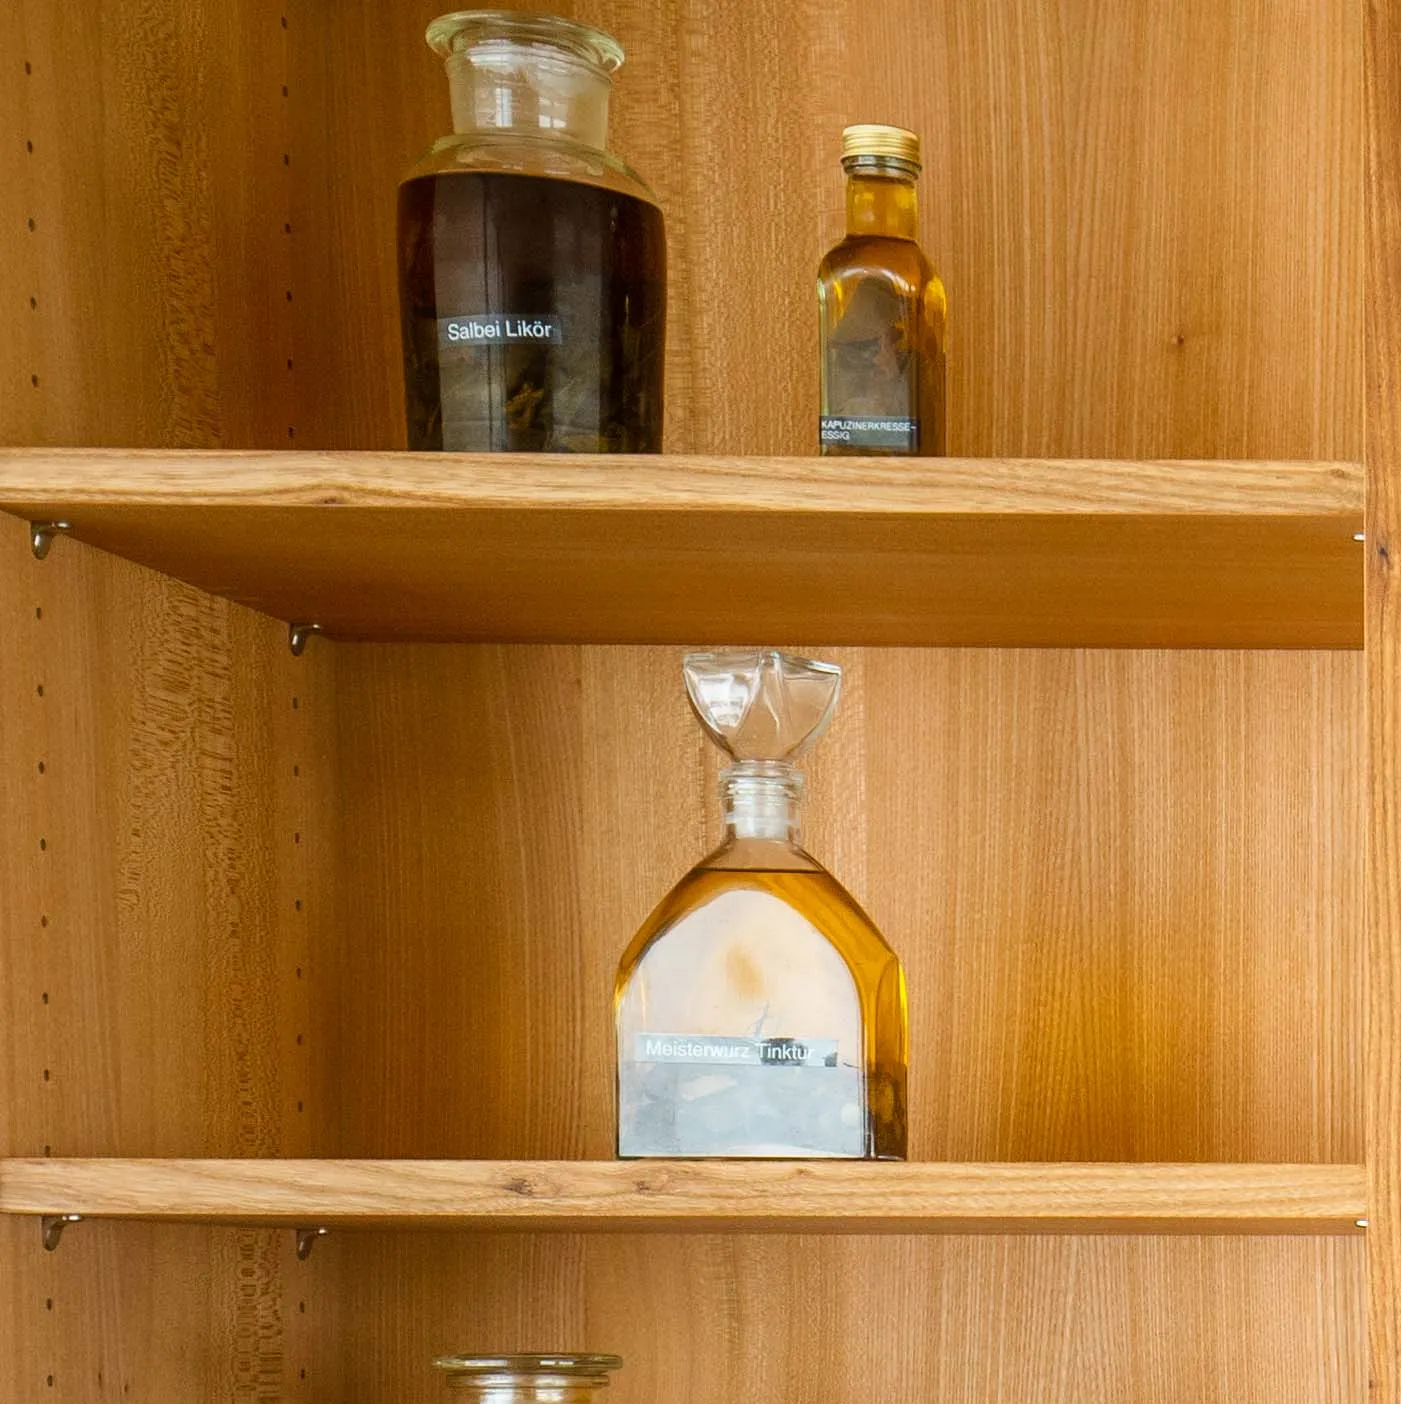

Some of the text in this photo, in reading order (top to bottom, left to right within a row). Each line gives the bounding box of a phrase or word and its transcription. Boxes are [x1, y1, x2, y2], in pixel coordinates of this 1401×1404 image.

[447, 319, 552, 341] Salbei Likör
[821, 430, 850, 440] ESSIG
[645, 1040, 815, 1060] Meisterwurz Tinktur
